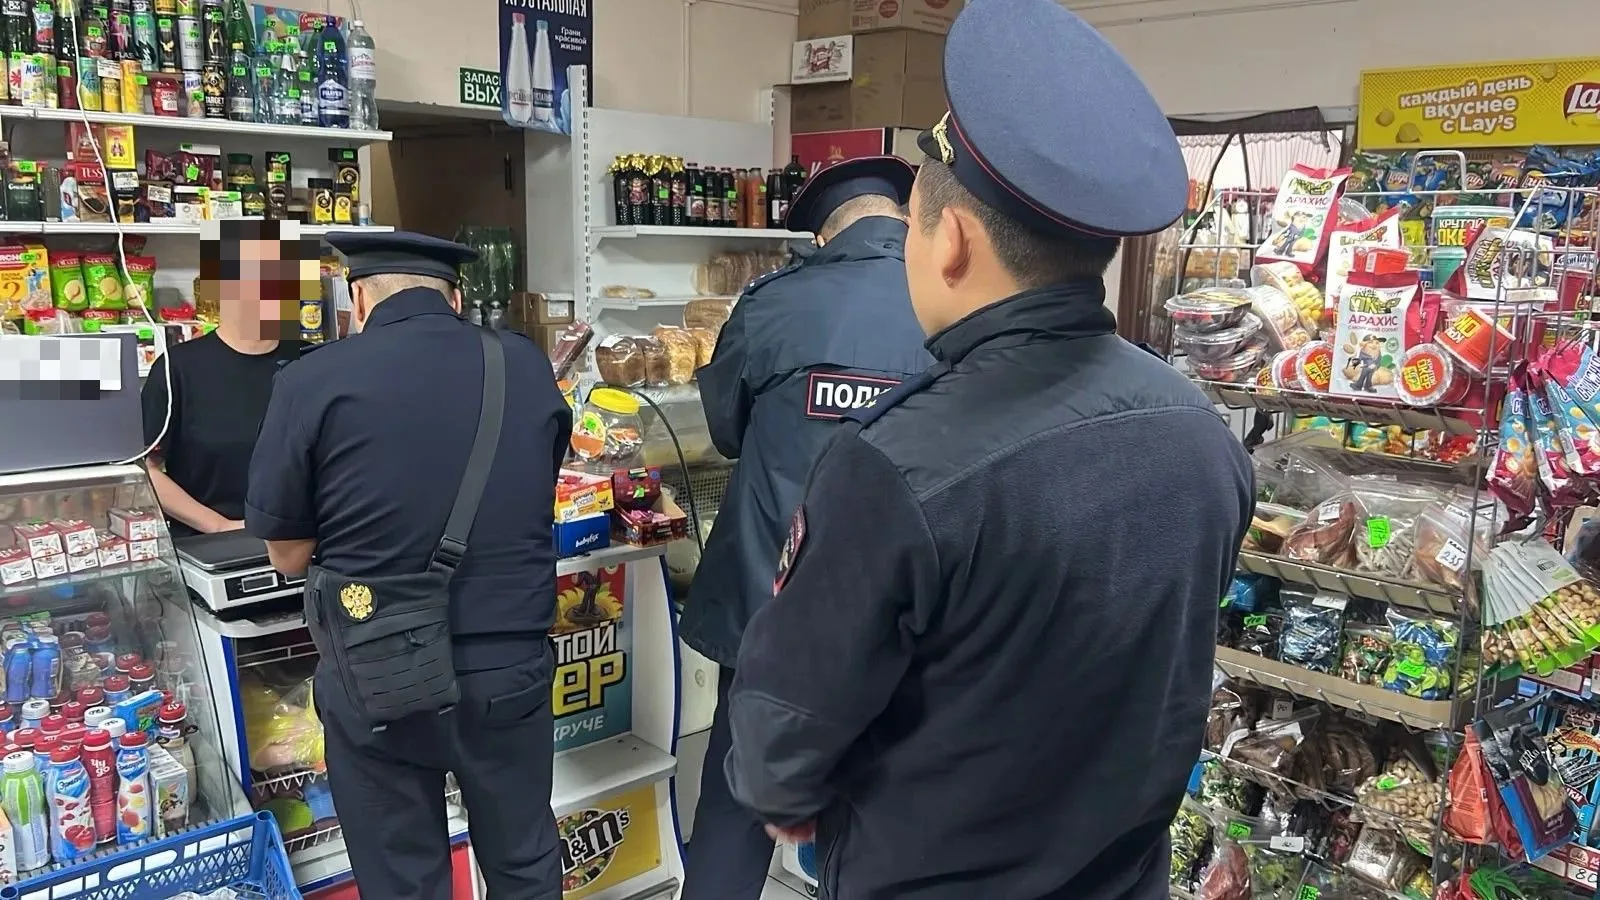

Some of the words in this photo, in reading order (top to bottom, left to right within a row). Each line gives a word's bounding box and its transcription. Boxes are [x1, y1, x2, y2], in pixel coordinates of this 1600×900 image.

[555, 34, 587, 45] красивой
[561, 26, 581, 36] Грани
[560, 43, 582, 51] жизни
[464, 83, 501, 105] ВЫХ
[1400, 83, 1478, 108] каждый
[1482, 76, 1532, 97] день
[1567, 82, 1600, 113] La
[1424, 97, 1517, 119] вкуснее
[1442, 119, 1455, 131] с
[1460, 114, 1515, 134] Lay's
[81, 167, 103, 178] TESS
[1285, 195, 1329, 206] АРАХИС
[1437, 229, 1467, 247] ОКЕ
[1348, 314, 1399, 327] АРАХИС
[553, 620, 616, 664] ТОЙ
[552, 650, 624, 716] ЕР
